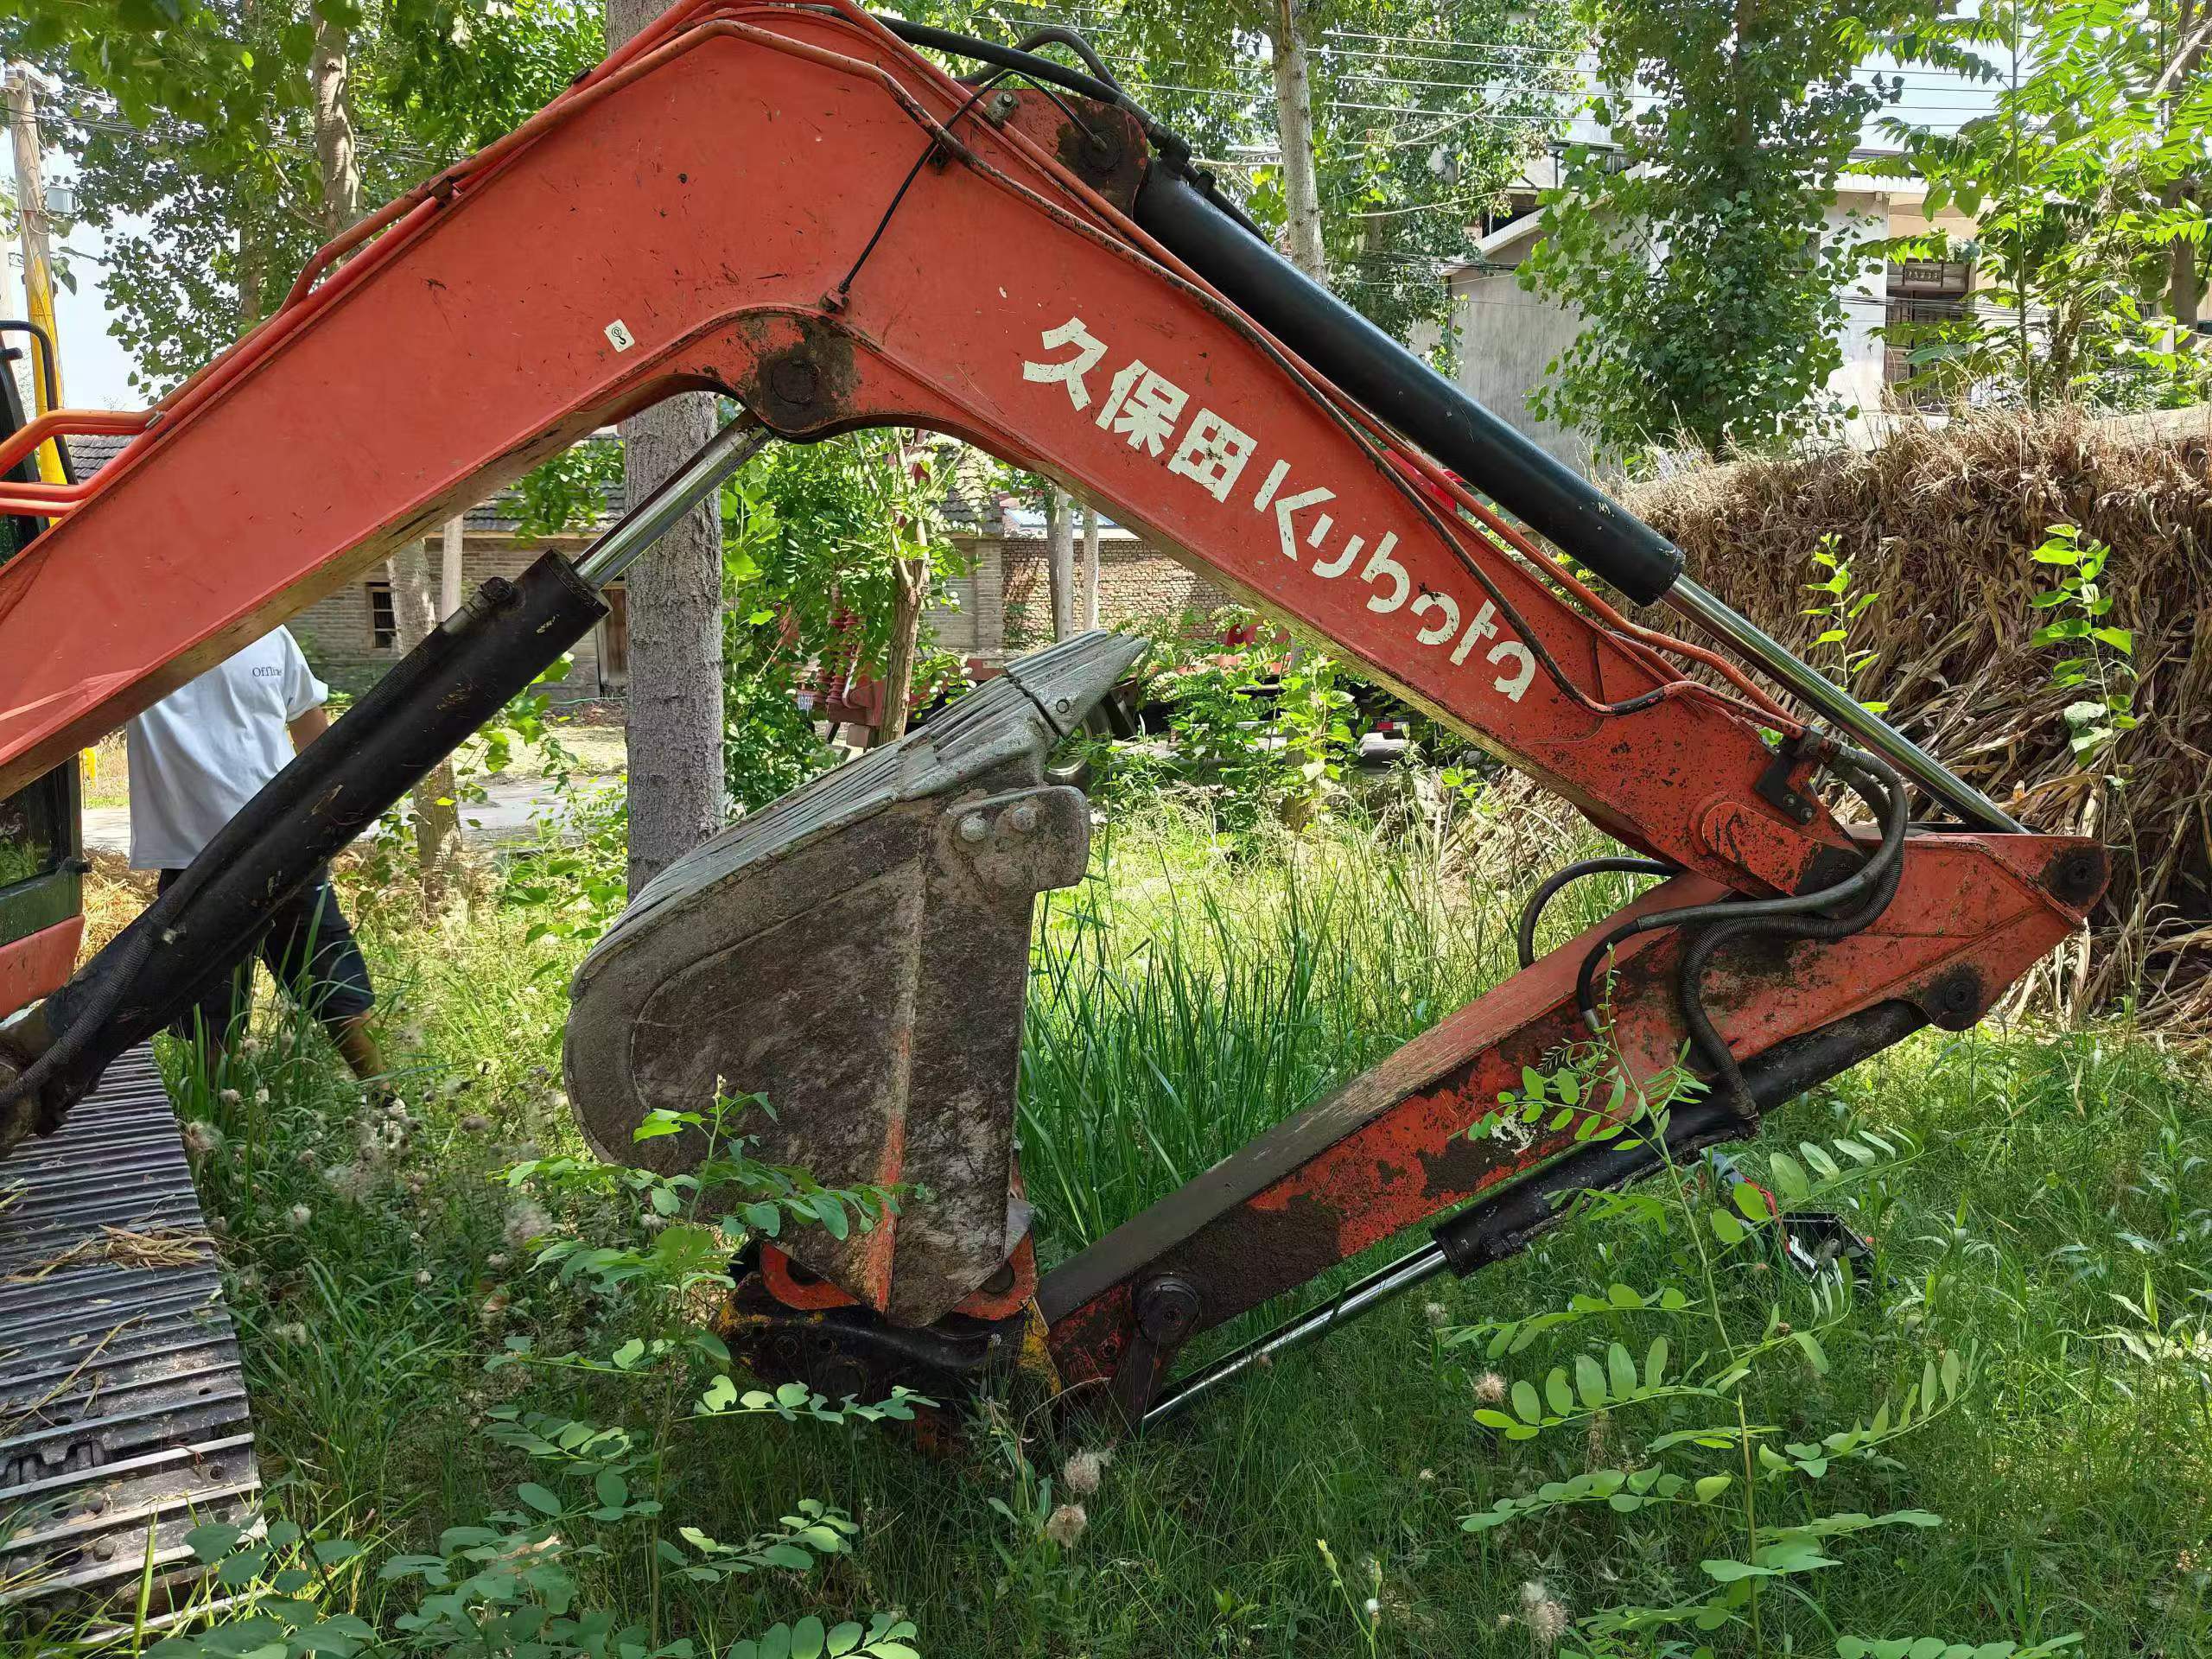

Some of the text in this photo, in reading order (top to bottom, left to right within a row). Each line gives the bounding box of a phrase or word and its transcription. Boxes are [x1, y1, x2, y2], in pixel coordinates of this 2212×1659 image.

[1022, 315, 1258, 504] 久保田
[1254, 459, 1536, 704] Kubota
